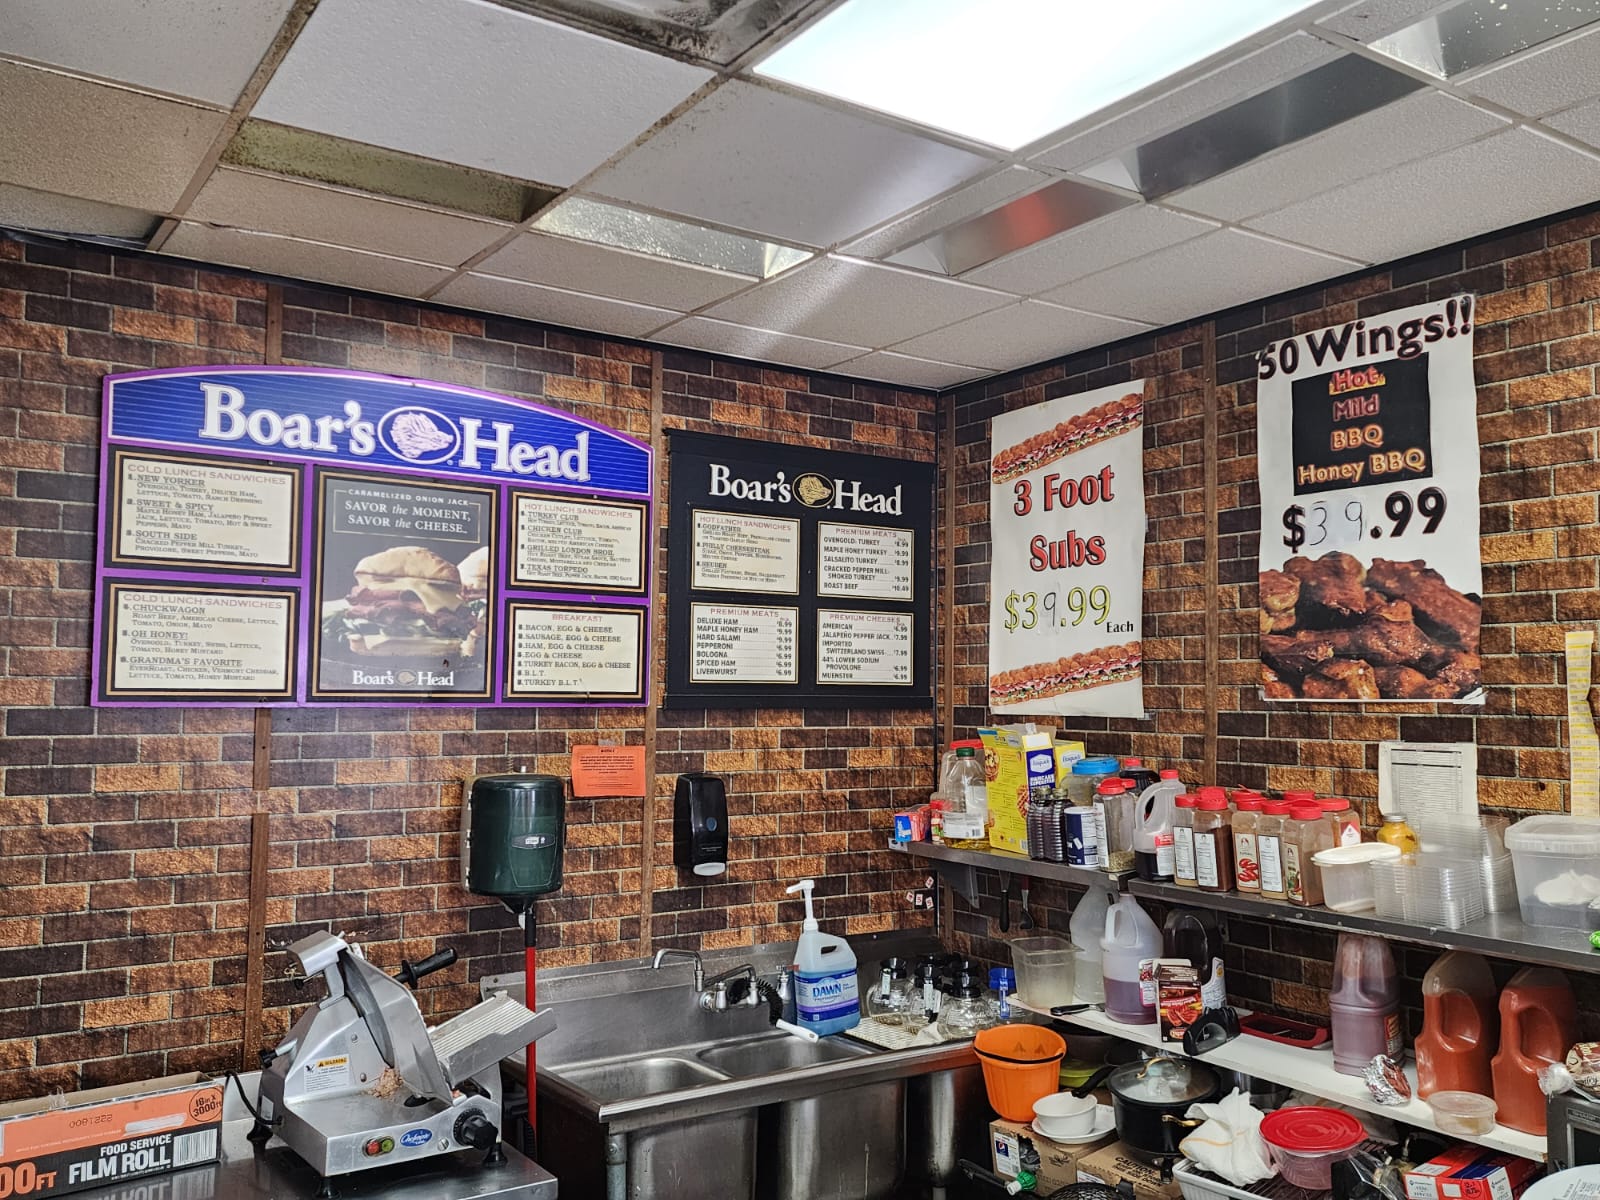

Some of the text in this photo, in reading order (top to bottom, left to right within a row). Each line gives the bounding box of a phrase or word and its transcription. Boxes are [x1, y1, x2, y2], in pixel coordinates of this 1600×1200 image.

[1258, 295, 1472, 380] 50 Wings!!
[1333, 366, 1379, 391] Hot
[1333, 393, 1380, 421] Mild
[199, 383, 591, 482] Boar's Head
[1331, 424, 1384, 450] BBQ
[127, 463, 286, 485] COLD LUNCH SANDWICHES
[1298, 447, 1426, 485] Honey BBQ
[137, 474, 205, 486] NEW YORKER
[349, 489, 412, 500] CARAMELIZED
[447, 498, 469, 506] JACK
[709, 464, 903, 516] Boar's Head
[1014, 465, 1115, 517] 3 Foot
[136, 498, 212, 511] SWEET SPICY
[345, 501, 471, 522] SAVOR the MOMENT,
[524, 502, 632, 518] HOT LUNCH SANDWICHES
[348, 515, 391, 527] SAVOR
[395, 518, 411, 529] the
[527, 524, 560, 532] CHICKEN
[135, 530, 197, 540] SOUTH SIDE
[836, 528, 869, 536] PREMIUM
[1030, 530, 1106, 572] Subs
[828, 571, 851, 579] SMOKED
[123, 594, 281, 608] COLD LUNCH SANDWICHES
[132, 603, 205, 613] CHUCKWAGON
[1004, 584, 1111, 634] $39.99
[1106, 621, 1134, 634] Each
[130, 656, 241, 666] GRANDMA'S FAVORITE
[352, 670, 454, 686] Boar's Head
[813, 984, 841, 997] DAWN
[100, 1142, 127, 1157] FOOD
[130, 1134, 172, 1150] SERVICE
[69, 1146, 171, 1184] FILM ROLL
